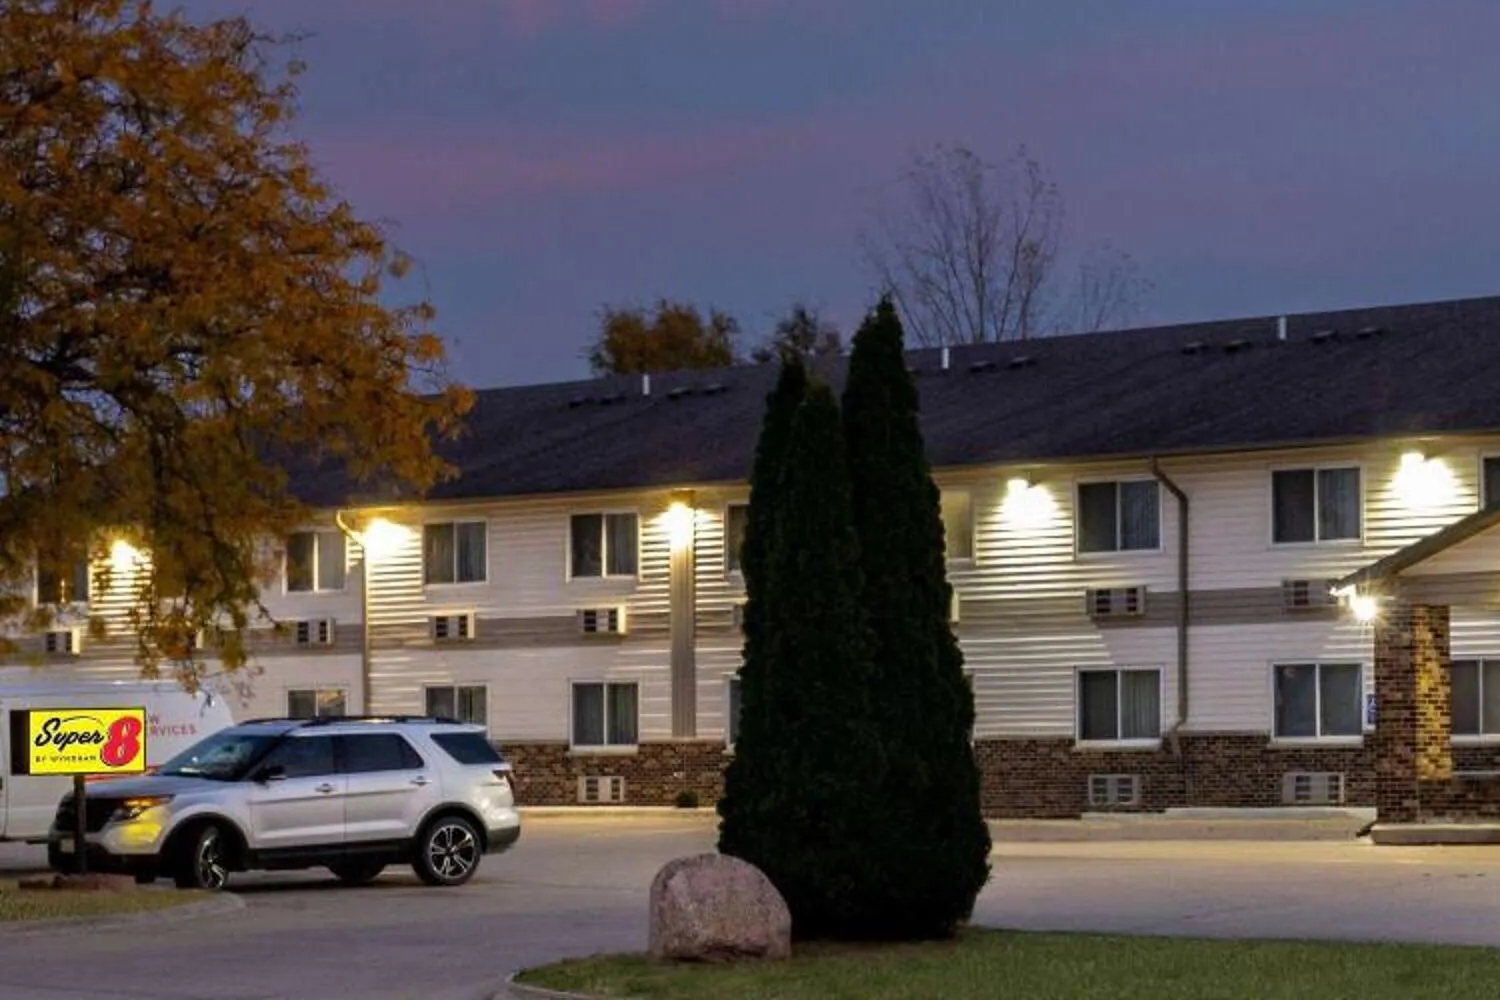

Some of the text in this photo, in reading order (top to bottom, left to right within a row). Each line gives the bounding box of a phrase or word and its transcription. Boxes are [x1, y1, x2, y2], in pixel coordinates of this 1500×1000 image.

[35, 716, 142, 766] Super 8
[148, 722, 197, 736] RVICES
